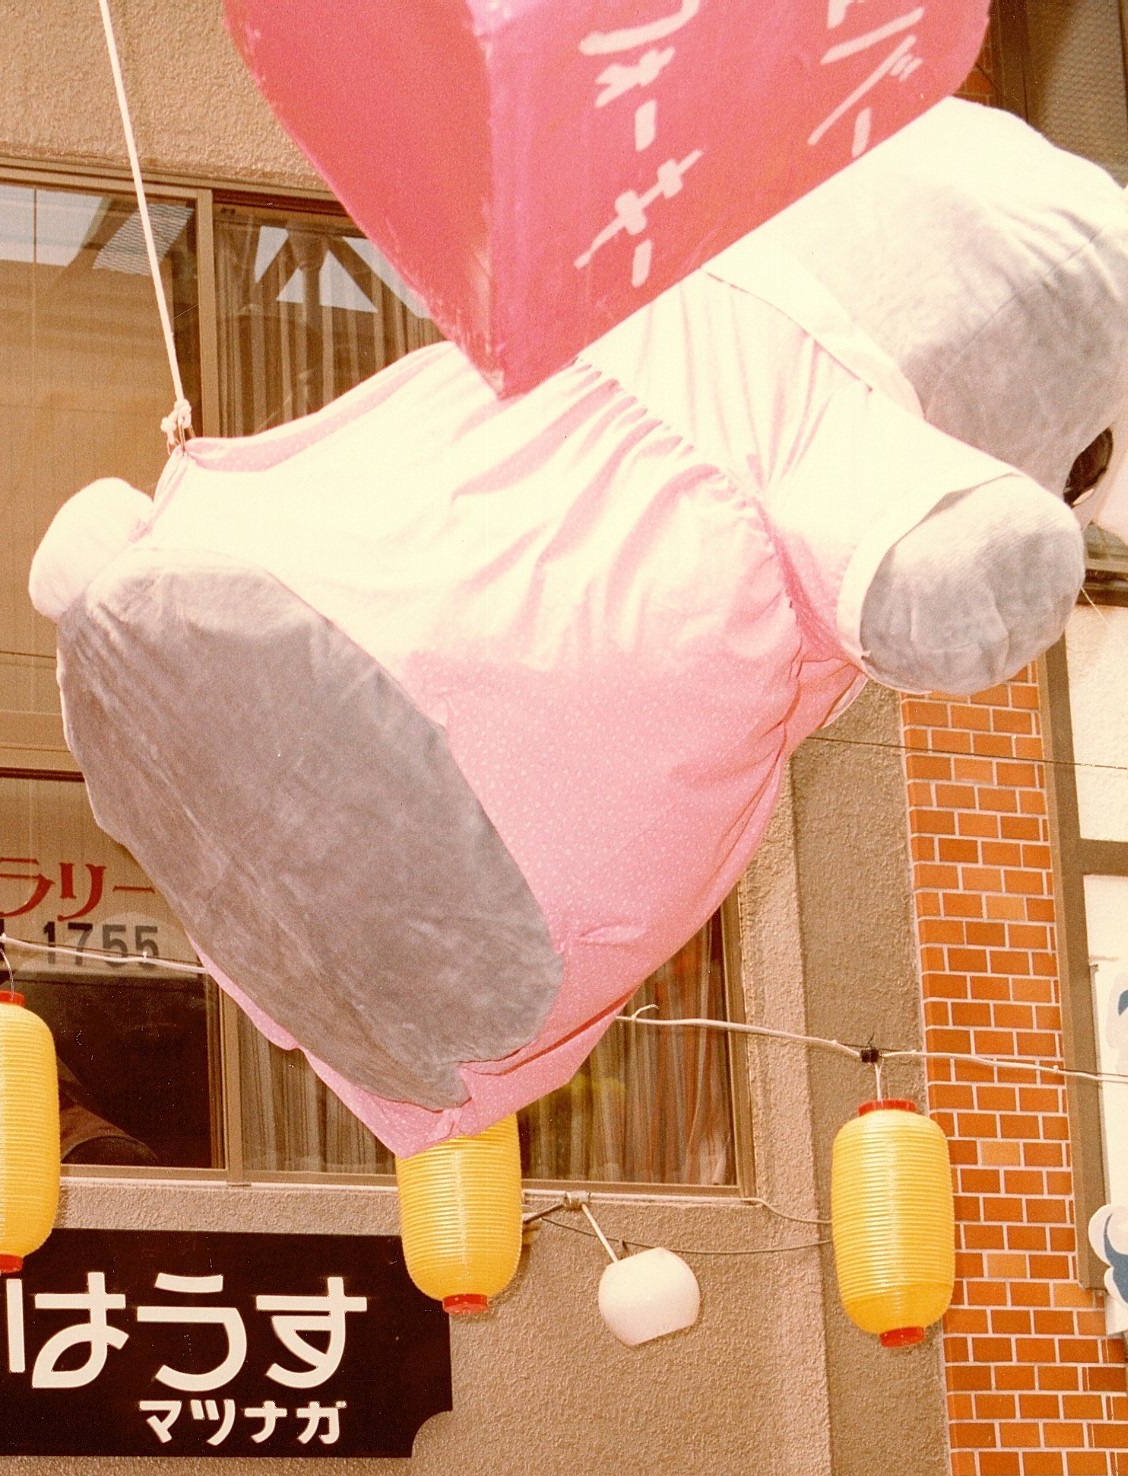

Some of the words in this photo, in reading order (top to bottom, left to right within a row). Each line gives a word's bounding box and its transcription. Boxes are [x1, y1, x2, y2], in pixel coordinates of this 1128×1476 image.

[808, 0, 924, 158] バー
[139, 1400, 346, 1446] マツナガ
